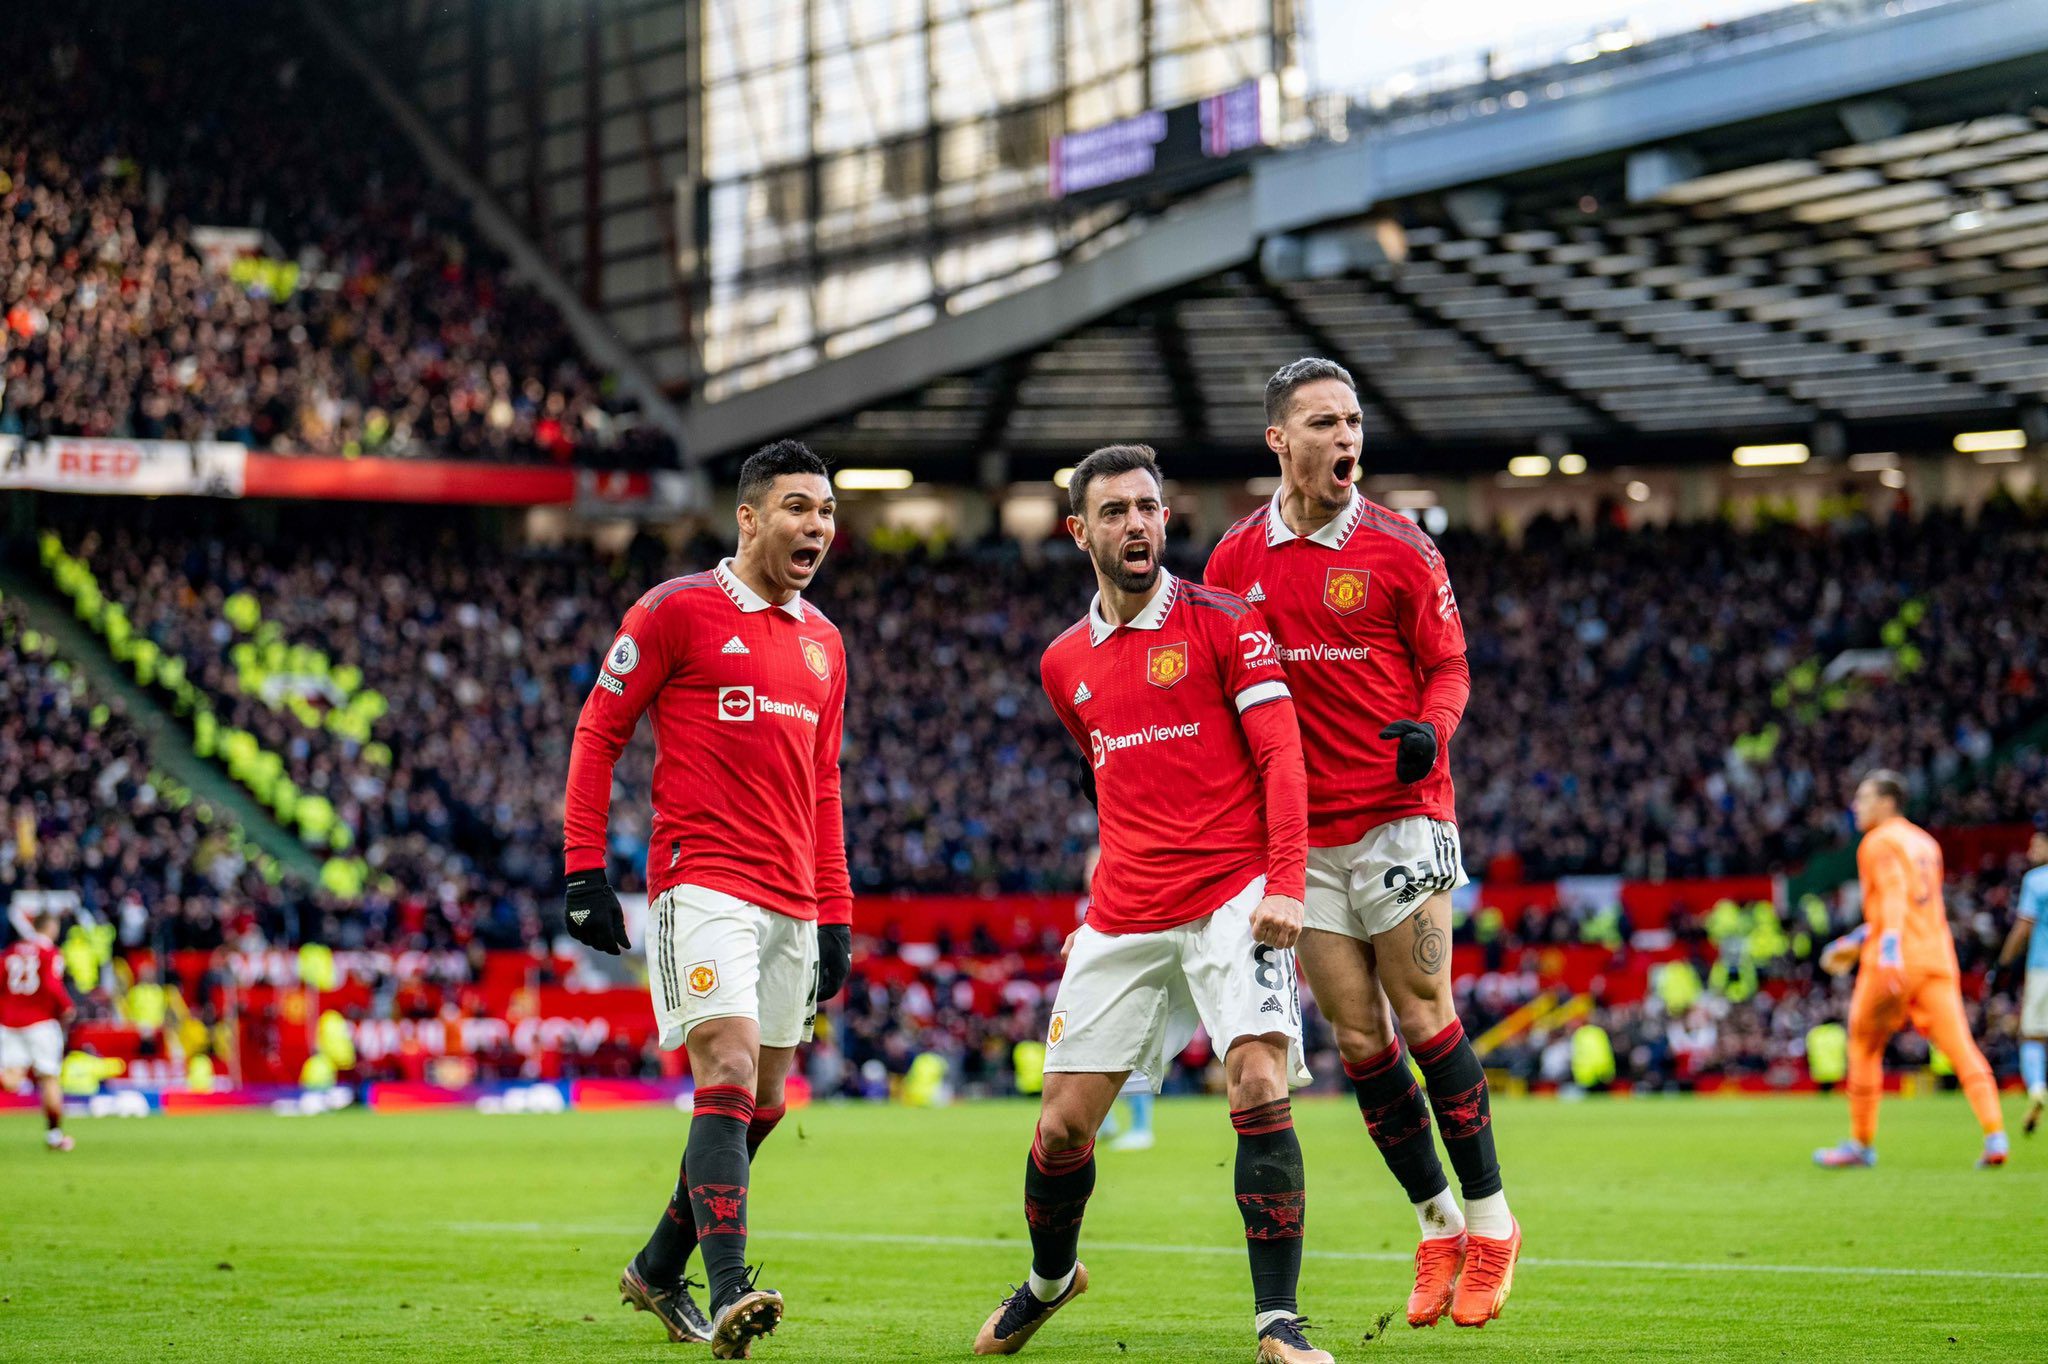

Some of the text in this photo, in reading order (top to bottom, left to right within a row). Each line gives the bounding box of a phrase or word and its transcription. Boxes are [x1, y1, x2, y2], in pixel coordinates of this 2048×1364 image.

[58, 445, 141, 477] RED
[721, 646, 750, 654] adidas
[1274, 643, 1370, 662] TeamViewer
[1073, 691, 1092, 705] adidas
[1103, 722, 1200, 752] TeamViewer
[5, 953, 40, 996] 23
[1253, 942, 1284, 991] 8
[1260, 1004, 1284, 1015] adida
